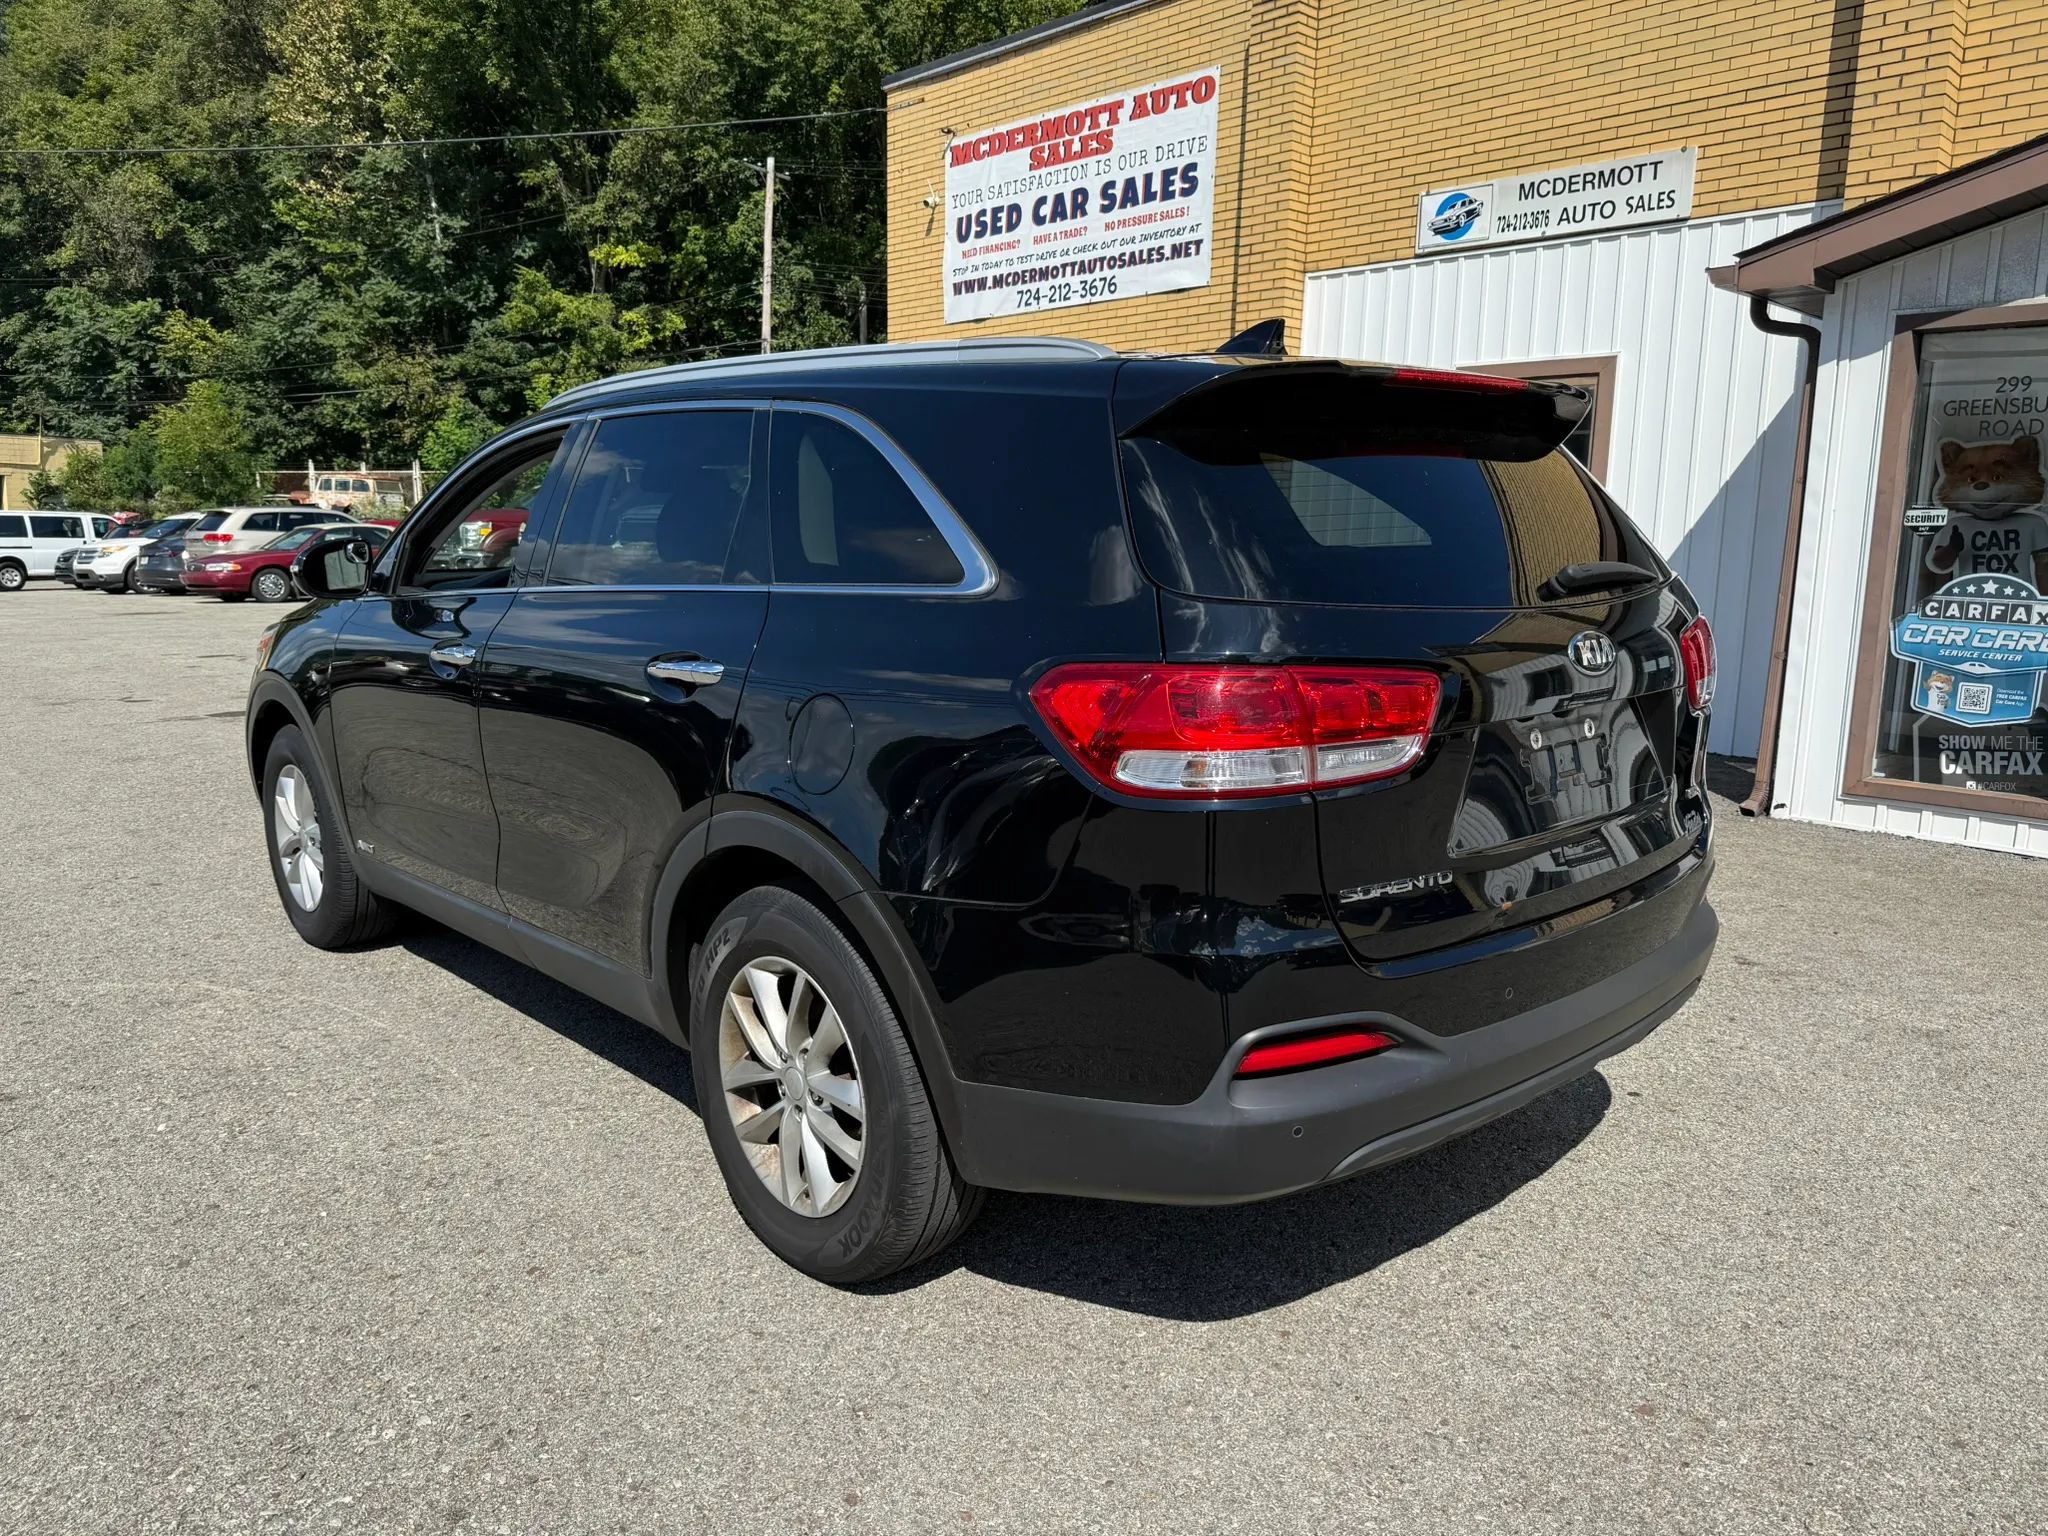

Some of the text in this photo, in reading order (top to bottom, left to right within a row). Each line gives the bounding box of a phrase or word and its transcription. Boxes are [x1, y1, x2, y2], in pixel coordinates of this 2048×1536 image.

[950, 75, 1217, 167] MCDERMOTT AUTO
[1029, 128, 1113, 171] SALES
[952, 135, 1208, 209] YOUR SATISFACTION IS OUR DRIVE
[1518, 160, 1664, 201] MCDERMOTT
[956, 162, 1199, 244] USED CAR SALES
[1496, 189, 1677, 233] 724-212-3676 AUTO SALES
[1104, 221, 1116, 232] NO
[1117, 212, 1158, 230] PRESSURE
[1033, 226, 1089, 245] HAVE A TRADE?
[953, 223, 1203, 277] STOP IN TODAY TO TEST DRIVE OR CHECK OUT OUR INVENTORY AT
[962, 239, 1021, 260] NEED FINANCING?
[953, 239, 1205, 296] WWW.MCDERMOTTAUTOSALES.NET
[1017, 275, 1118, 308] 724-212-3676
[1995, 376, 2033, 394] 299
[1979, 418, 2045, 438] ROAD
[1904, 514, 1946, 524] SECURITY
[1970, 529, 2021, 552] CAR
[1971, 553, 2020, 574] FOX
[1902, 623, 1971, 646] CAR
[1577, 639, 1612, 666] KIA
[1938, 649, 2023, 662] SERVICE CENTER
[1939, 735, 2044, 751] SHOW ME THE
[1940, 750, 2044, 775] CARFAX
[1977, 781, 2017, 792] #CARFOX
[1340, 870, 1453, 903] SORENTO
